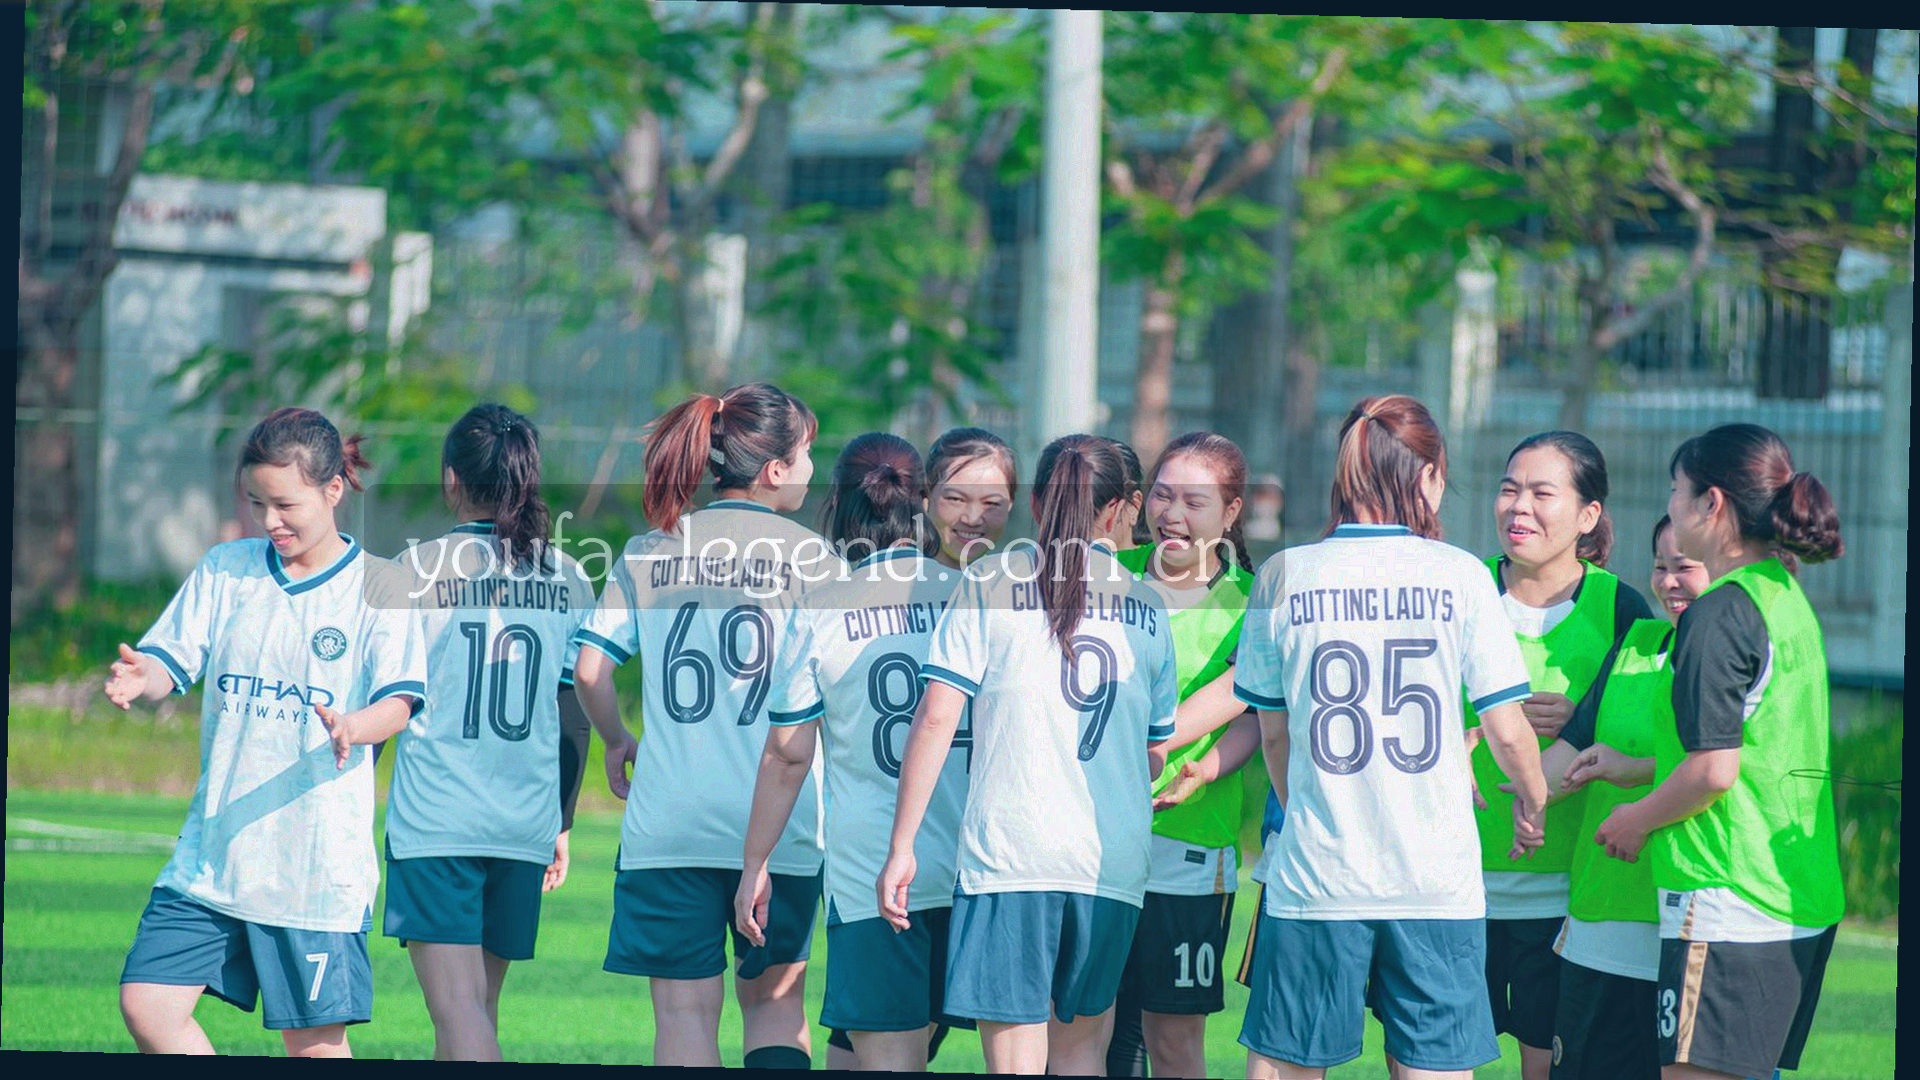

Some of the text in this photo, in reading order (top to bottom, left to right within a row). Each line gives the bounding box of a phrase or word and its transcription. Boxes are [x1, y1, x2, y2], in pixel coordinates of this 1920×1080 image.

[436, 577, 569, 614] CUTTING LADYS
[651, 556, 792, 591] CUTTING LADYS
[844, 602, 925, 642] CUTTING
[1099, 592, 1157, 637] LADYS
[1289, 587, 1453, 626] CUTTING LADYS
[460, 622, 541, 741] 10
[662, 601, 775, 726] 69
[217, 673, 334, 707] ETIHAD
[1060, 634, 1118, 761] 9
[1309, 638, 1442, 775] 85
[220, 701, 308, 725] AIRWAYS
[305, 952, 328, 1002] 7
[1174, 942, 1215, 987] 10
[1657, 989, 1676, 1038] 3
